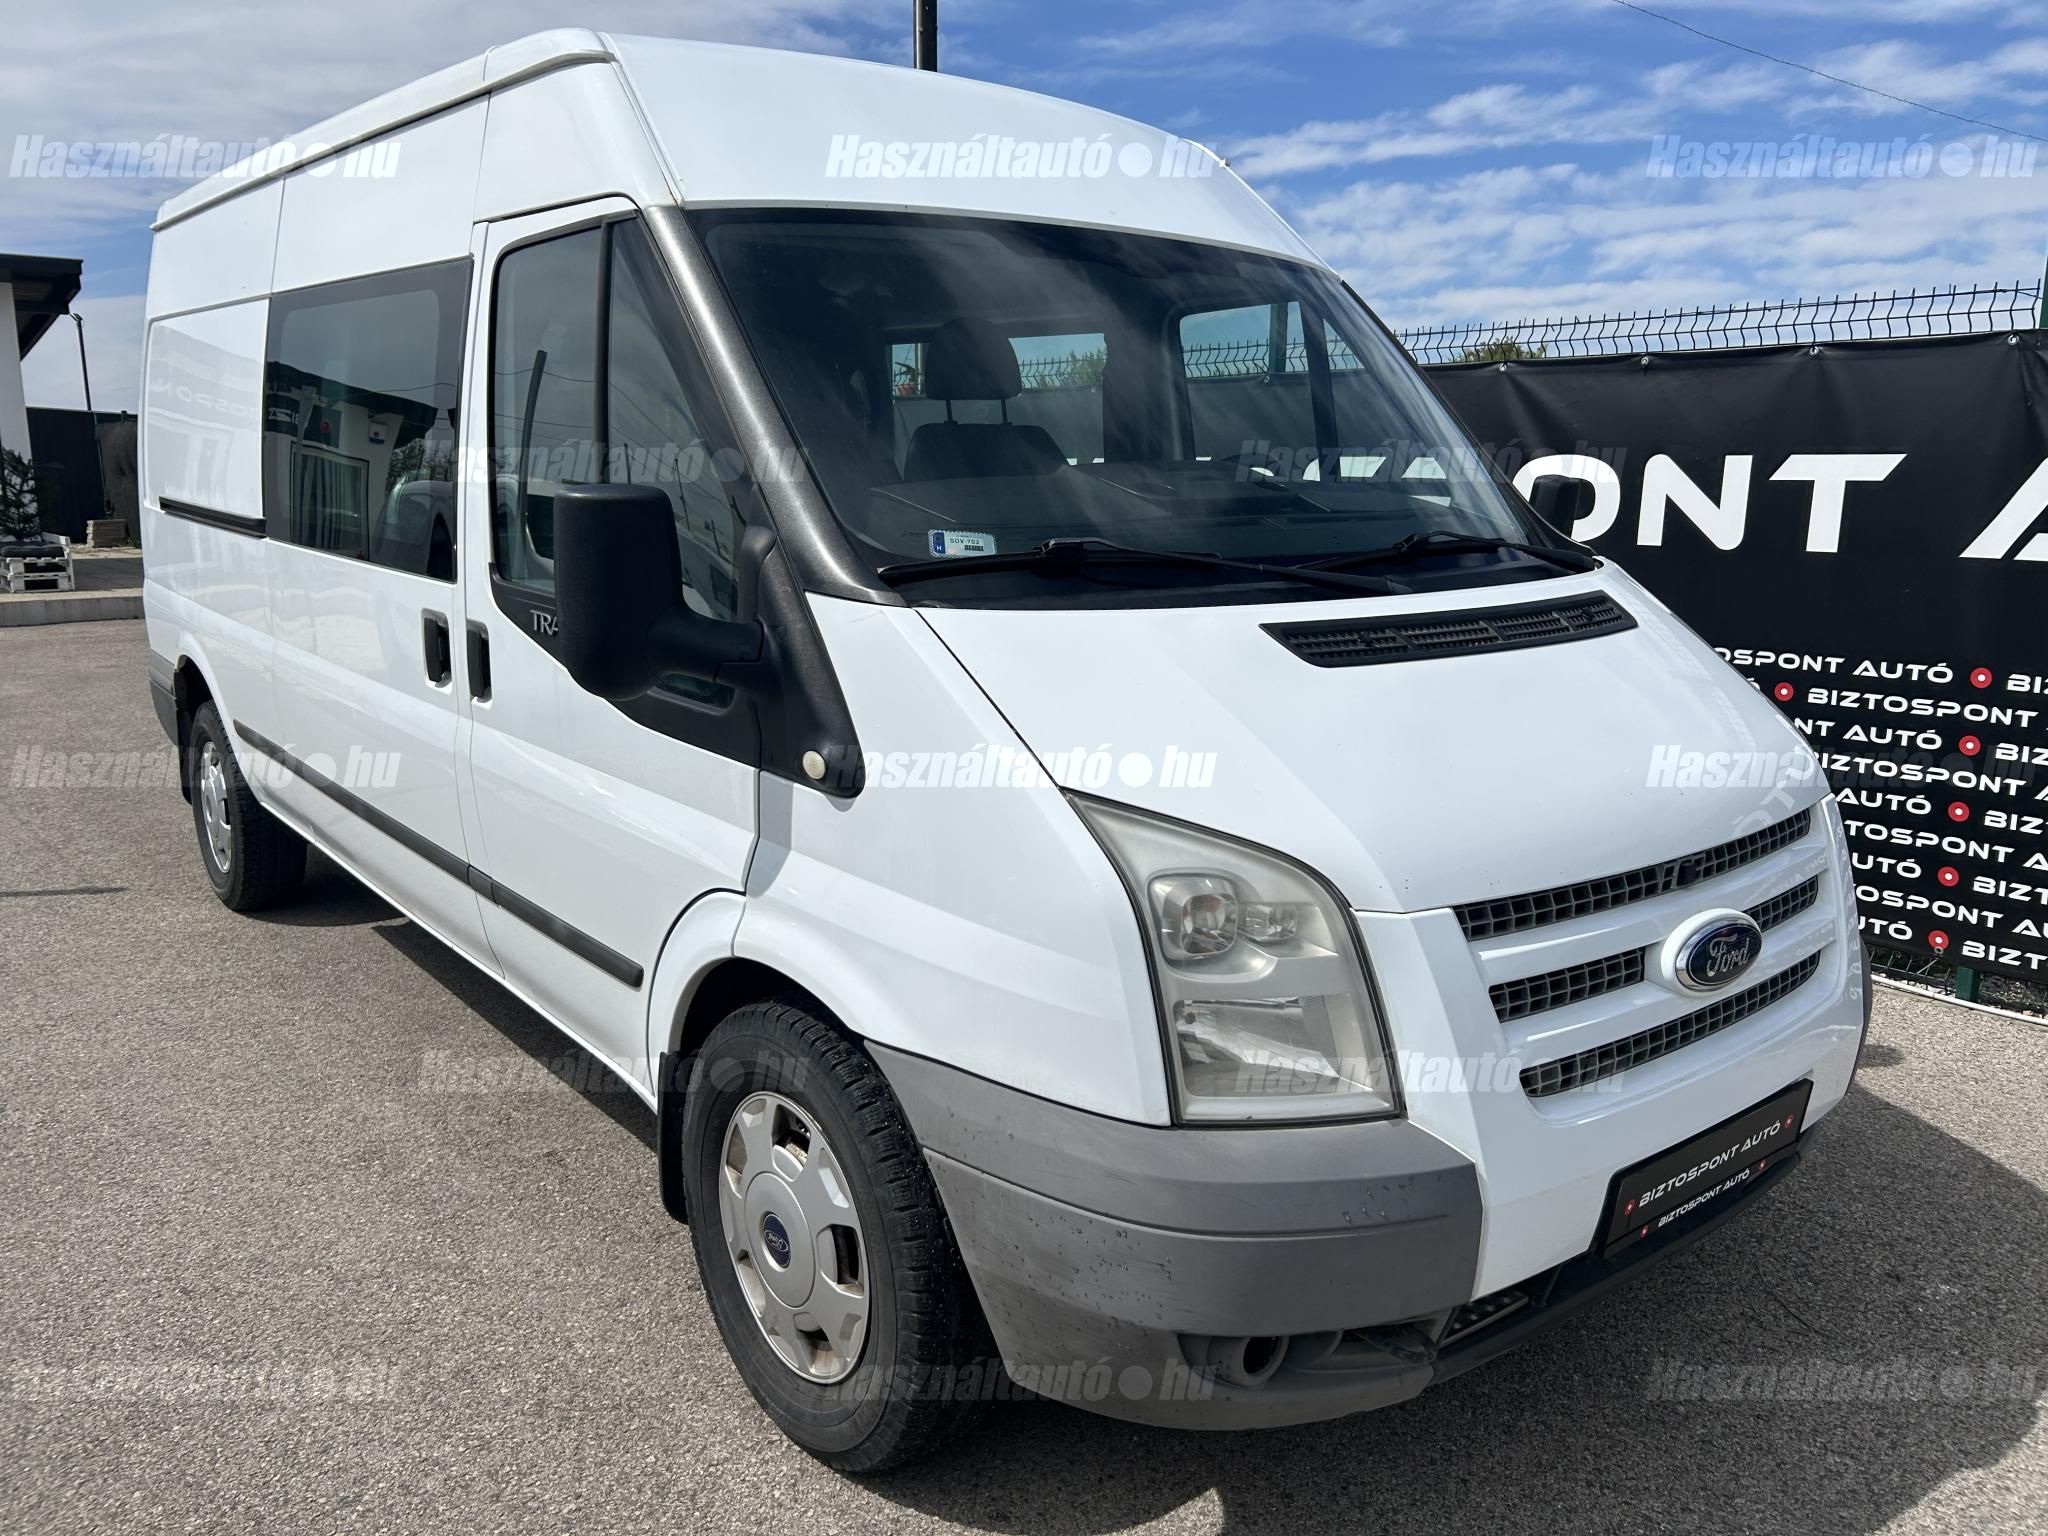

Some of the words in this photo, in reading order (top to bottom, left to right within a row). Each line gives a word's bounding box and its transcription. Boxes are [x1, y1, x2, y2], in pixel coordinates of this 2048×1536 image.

[1852, 659, 1954, 684] AUTÓ
[2006, 673, 2048, 694] BI
[1808, 687, 2039, 728] BIZTOSPONT
[1842, 724, 1942, 750] AUTÓ
[1814, 750, 2027, 796] IZTOSPONT
[1836, 787, 1932, 815] AUTÓ
[1984, 809, 2048, 835] BIZ
[1844, 819, 2016, 863] TOSPONT
[1851, 852, 1922, 879] UTÓ
[1853, 884, 2004, 929] OSPONT
[2011, 918, 2048, 939] A
[1706, 933, 1751, 977] Ford
[1961, 940, 2048, 970] BIZT
[1638, 1144, 1740, 1208] BIZTOSPONT
[1740, 1119, 1781, 1153] AUTÓ
[1657, 1184, 1722, 1227] BIZTOSPONT
[1722, 1169, 1750, 1190] AUTÓ
